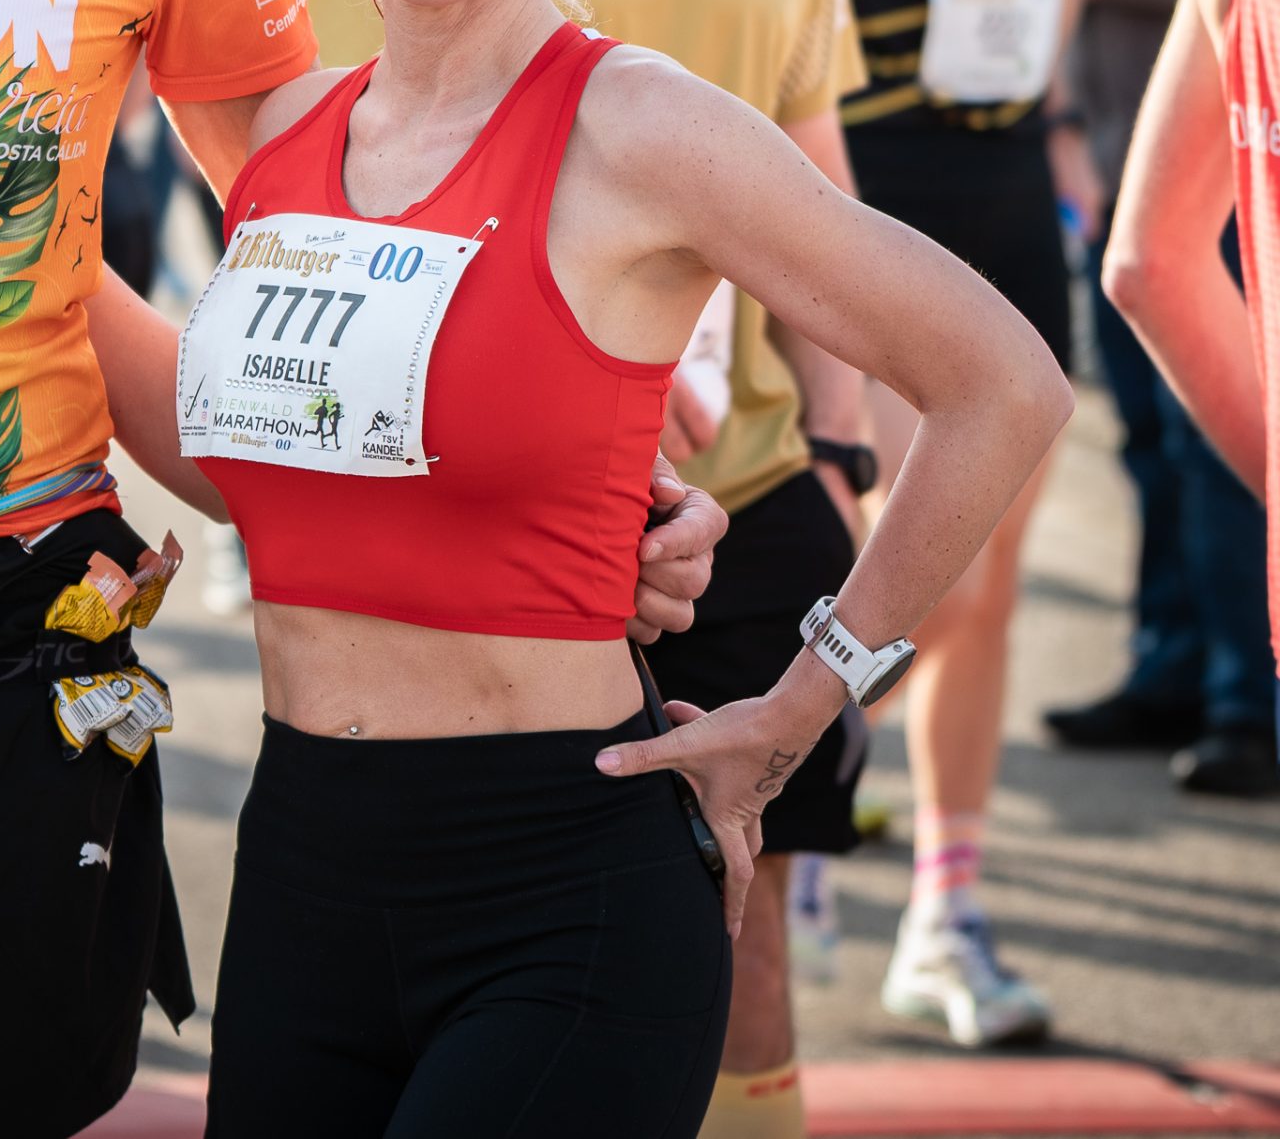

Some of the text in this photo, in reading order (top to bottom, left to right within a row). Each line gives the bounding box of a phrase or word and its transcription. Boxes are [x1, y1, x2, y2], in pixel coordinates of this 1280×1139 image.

[46, 139, 87, 162] CÁLIDA
[240, 230, 341, 278] Bitburger
[368, 242, 424, 283] 0.0
[245, 284, 367, 348] 7777
[242, 354, 332, 387] ISABELLE
[216, 397, 293, 417] BIENWALD
[212, 412, 302, 438] MARATHON
[362, 442, 404, 457] KANDEL
[382, 434, 398, 444] TSV
